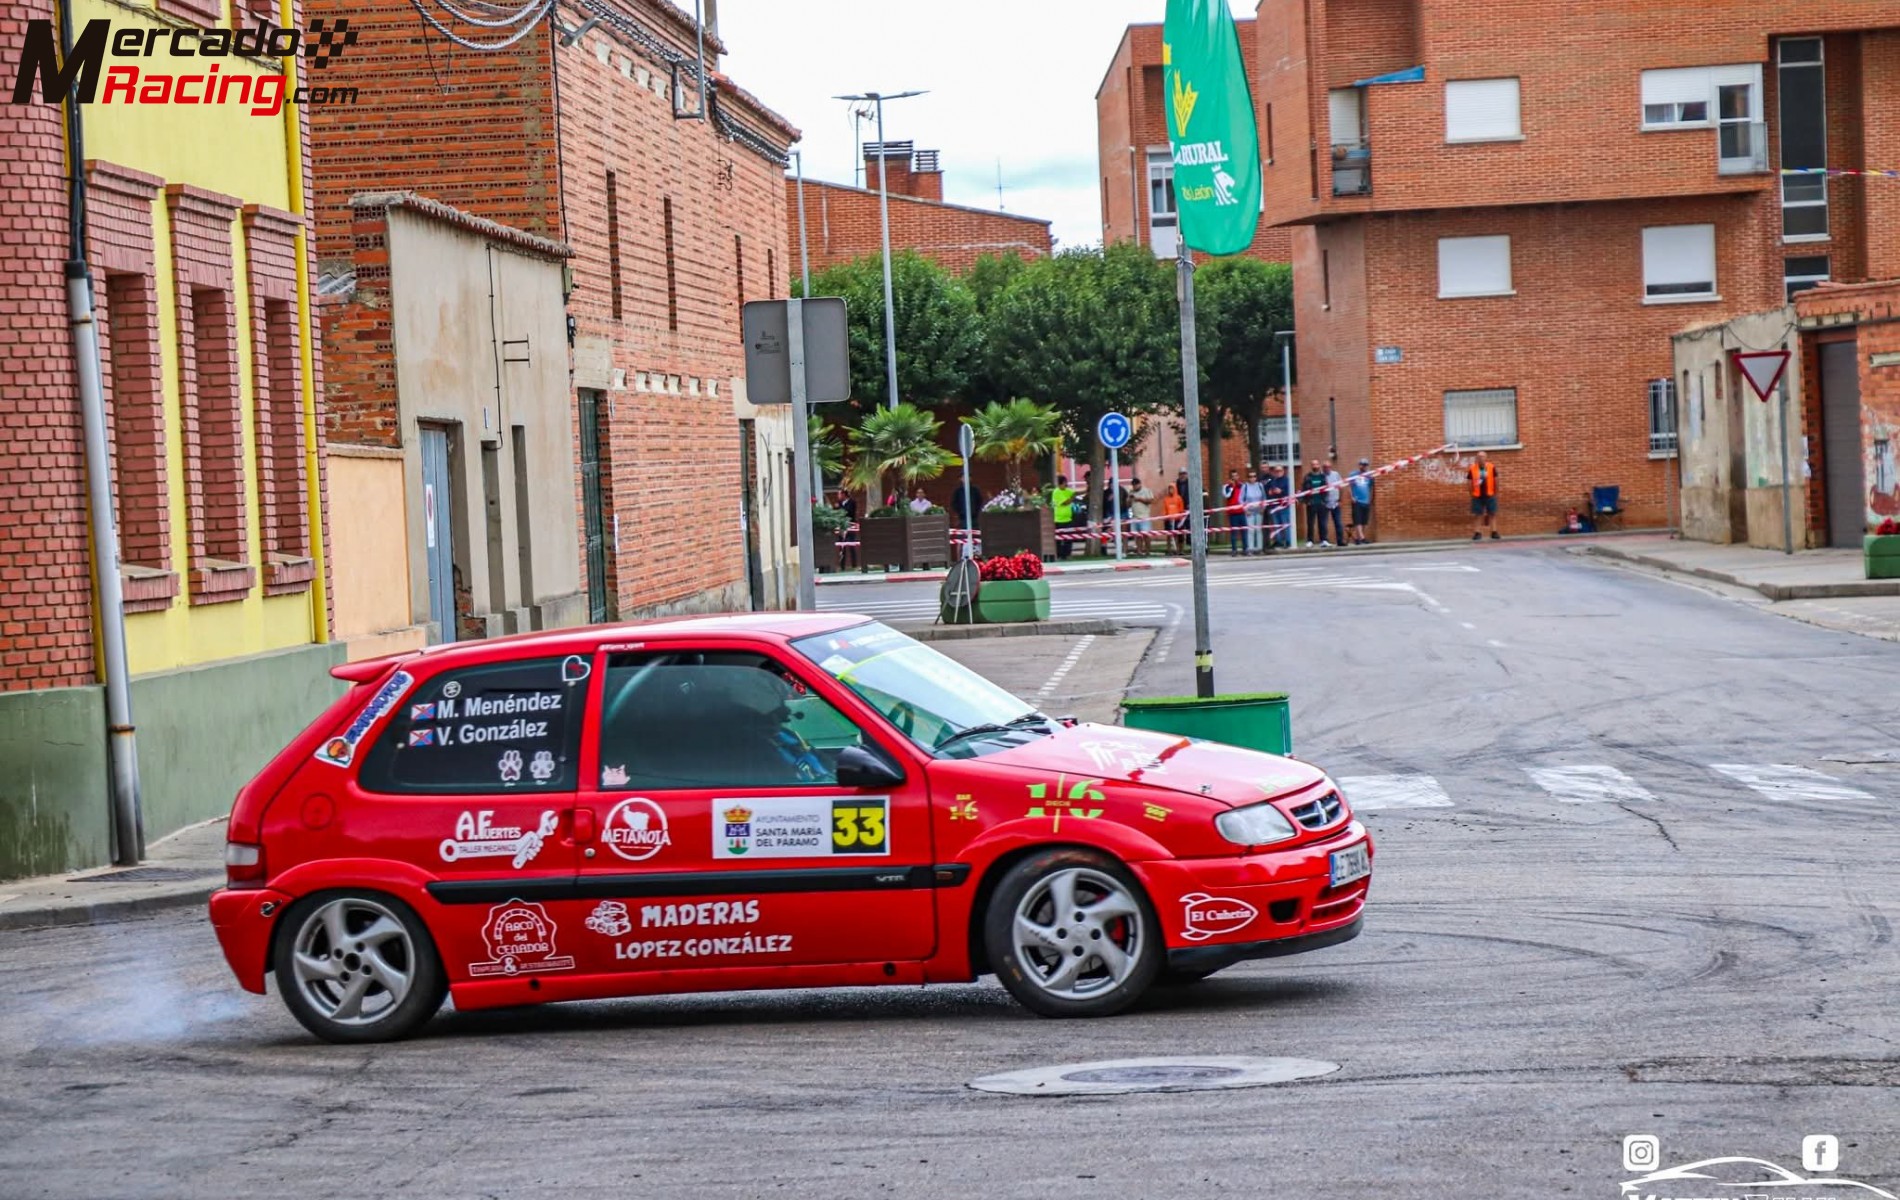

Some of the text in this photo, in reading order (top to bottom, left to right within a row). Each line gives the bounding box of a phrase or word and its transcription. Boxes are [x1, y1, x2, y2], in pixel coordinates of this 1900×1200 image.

[438, 691, 562, 719] M. Menéndez
[437, 719, 548, 747] V. González
[755, 814, 820, 824] AYUNTAMIENTO
[833, 807, 886, 847] 33
[601, 827, 673, 846] METANOIA
[755, 828, 788, 837] SANTA
[755, 838, 774, 848] DEL
[640, 900, 760, 928] MADERAS
[1191, 911, 1205, 922] El
[505, 921, 534, 932] ARCO
[513, 932, 528, 941] del
[615, 931, 793, 960] LOPEZ GONZÁLEZ
[504, 957, 517, 974] &
